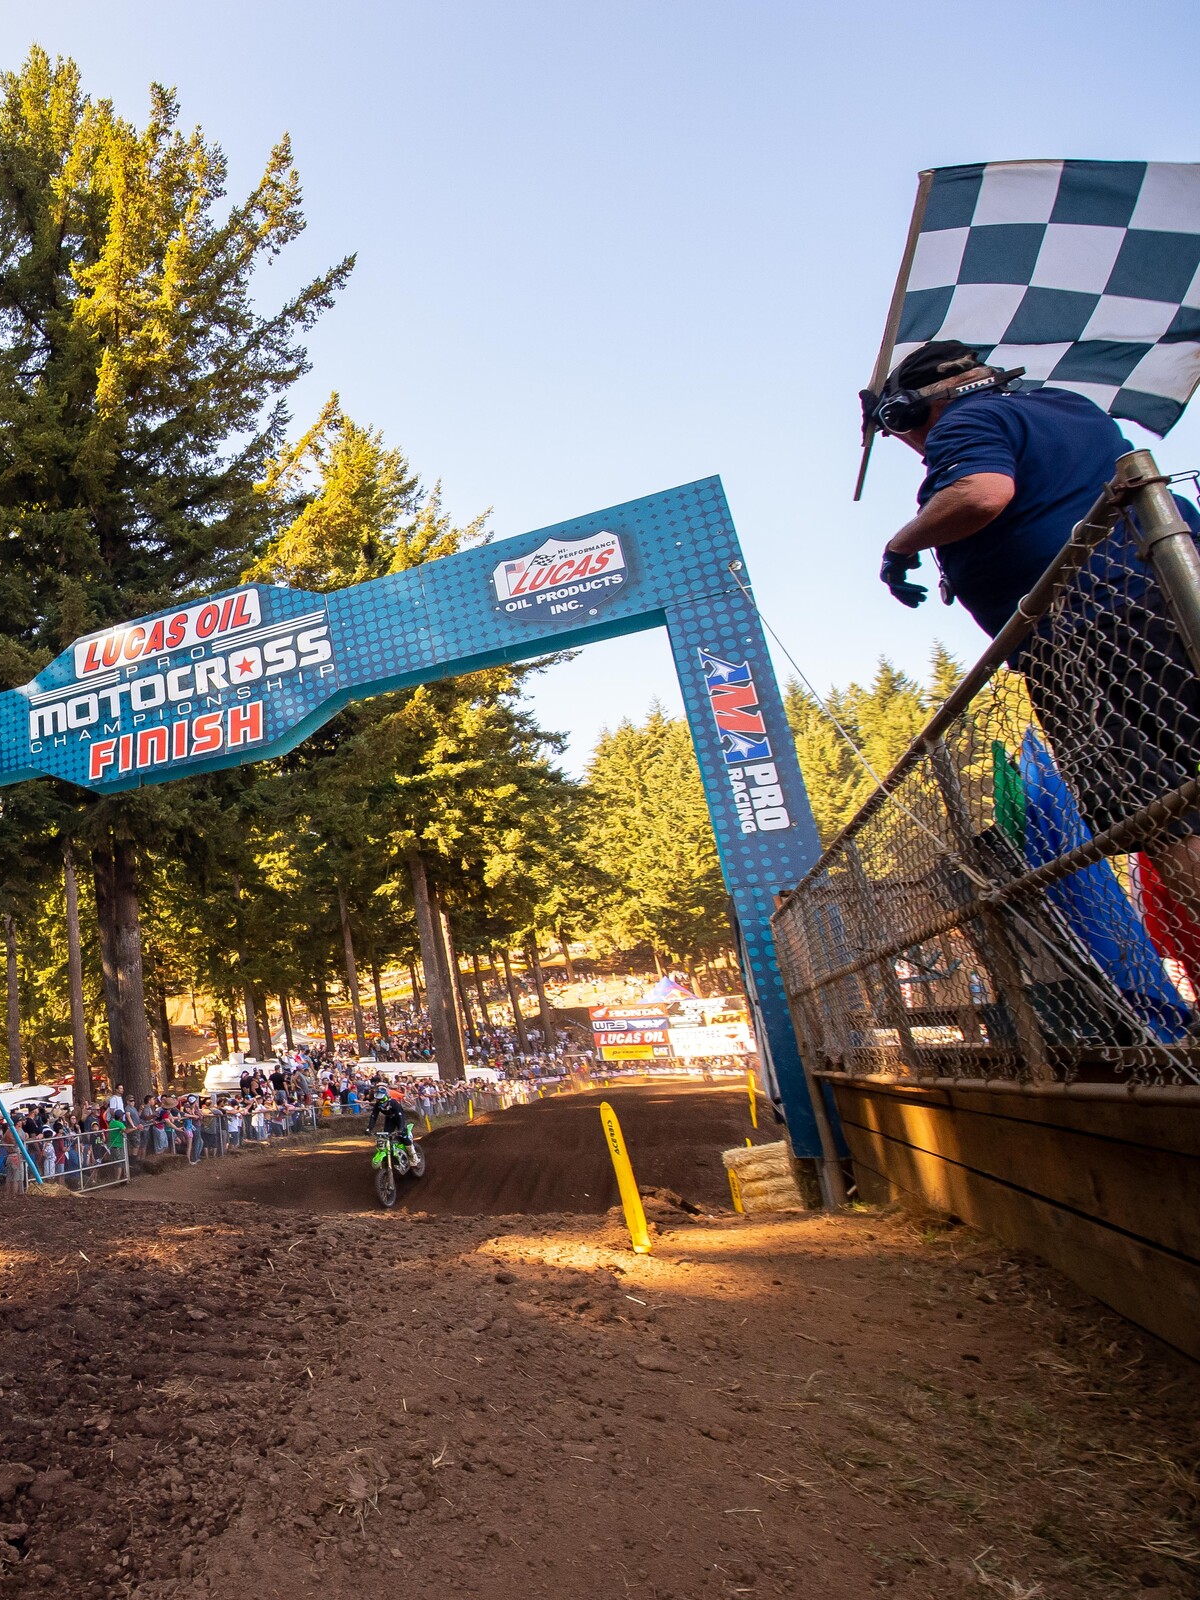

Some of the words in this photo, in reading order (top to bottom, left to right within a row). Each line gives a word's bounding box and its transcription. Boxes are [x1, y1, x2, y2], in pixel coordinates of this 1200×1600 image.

[956, 376, 995, 393] TITAN
[559, 540, 617, 560] PERFORMANCE
[510, 548, 615, 597] LUCAS
[505, 598, 533, 612] OIL
[536, 573, 624, 605] PRODUCTS
[550, 599, 584, 616] INC.
[82, 613, 189, 674] LUCAS
[195, 593, 253, 639] OIL
[125, 645, 206, 679] PRO
[29, 625, 333, 740] MOTOCROSS
[31, 663, 335, 754] CHAMPIONSHIP
[697, 647, 773, 764] AMA
[88, 699, 264, 781] FINISH
[727, 767, 758, 834] RACING
[743, 762, 791, 832] PRO
[593, 1021, 627, 1031] WPS
[608, 1007, 665, 1018] HONDA
[711, 1013, 742, 1024] KTM
[600, 1033, 642, 1045] LUCAS
[643, 1031, 665, 1043] OIL
